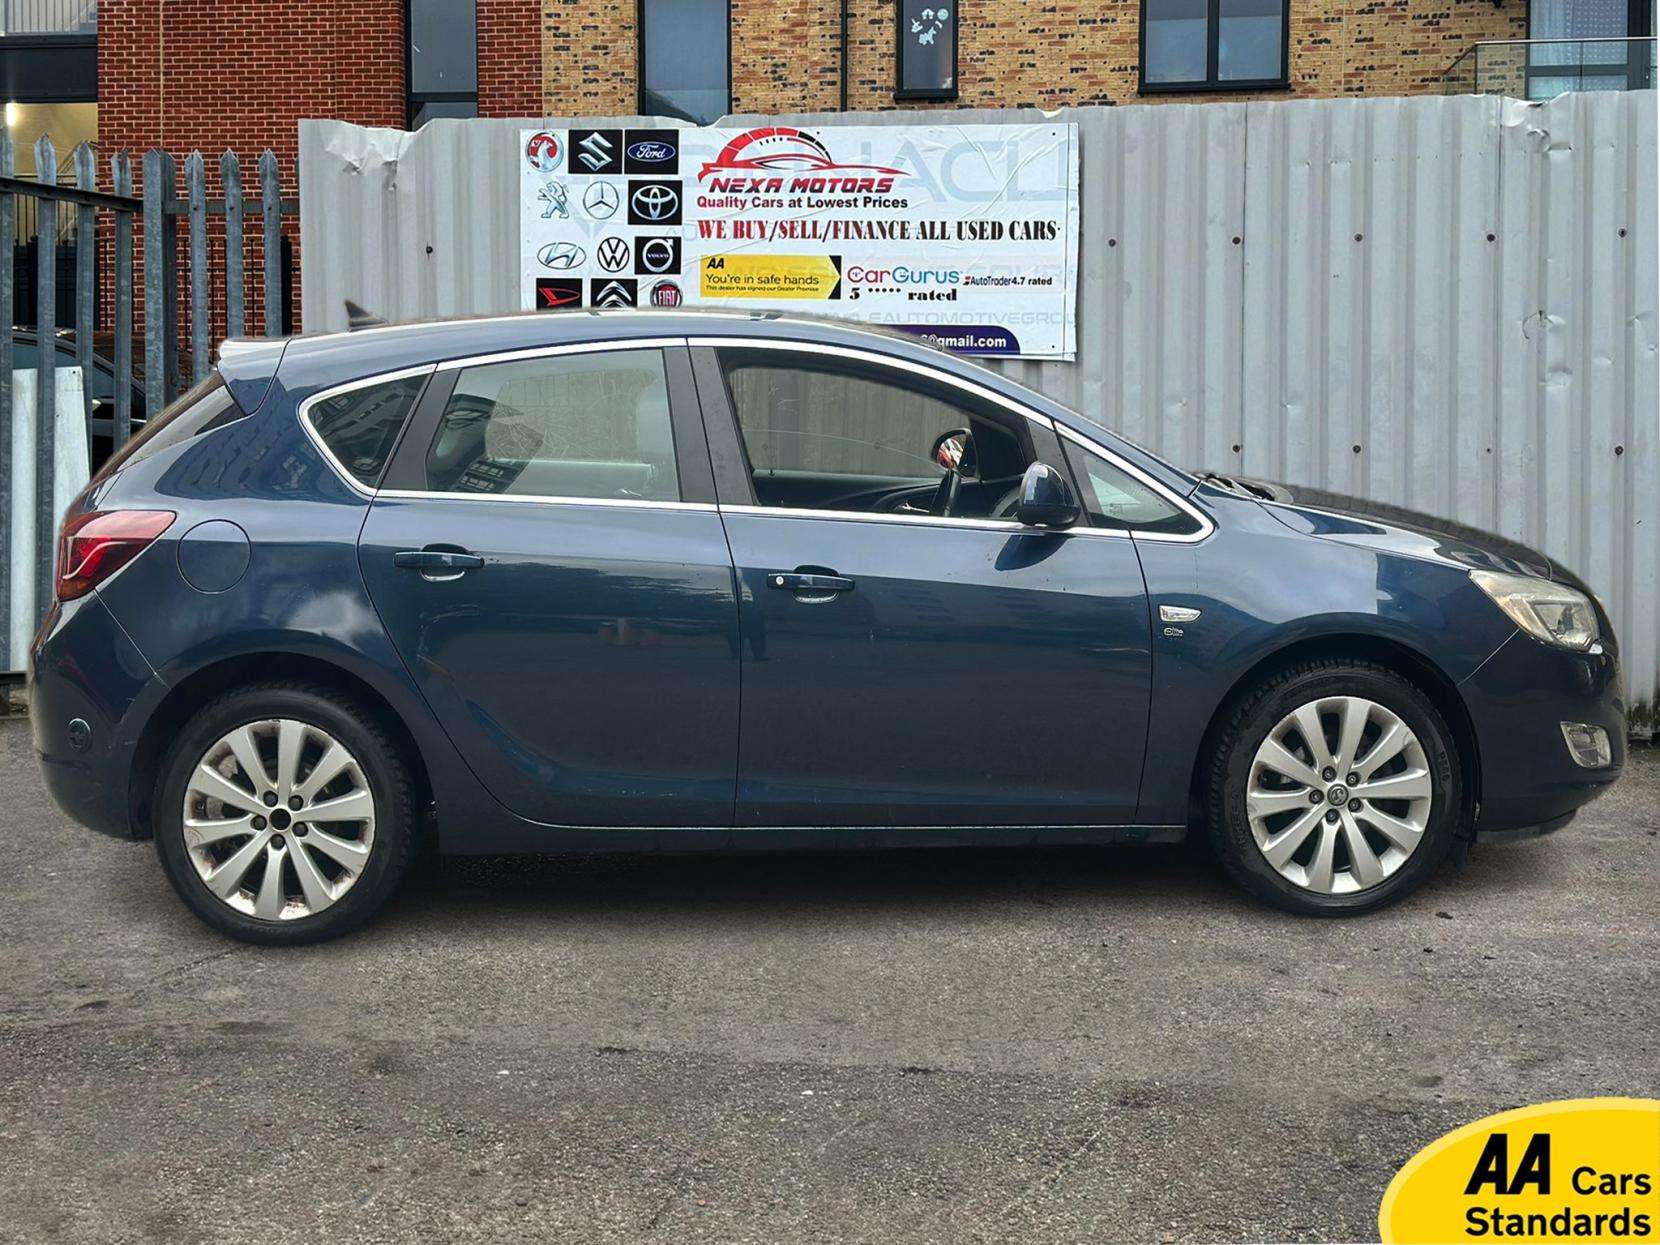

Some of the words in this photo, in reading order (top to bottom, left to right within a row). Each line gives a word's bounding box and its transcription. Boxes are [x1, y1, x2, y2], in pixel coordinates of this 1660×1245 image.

[636, 145, 667, 159] Ford
[709, 177, 784, 194] NEXA
[789, 177, 895, 194] MOTORS
[697, 196, 747, 211] Quality
[752, 196, 784, 209] Cars
[788, 197, 802, 208] at
[807, 196, 858, 209] Lowest
[863, 196, 908, 209] Prices
[697, 219, 726, 240] WE
[916, 220, 951, 241] ALL
[956, 220, 1004, 241] USED
[1008, 220, 1057, 241] CARS
[707, 257, 725, 270] AA
[706, 273, 741, 285] You're
[744, 273, 755, 284] in
[757, 273, 781, 285] safe
[784, 274, 820, 286] hands
[847, 265, 960, 284] CarGurus
[1028, 277, 1053, 286] rated
[658, 290, 676, 305] FIAT
[849, 287, 861, 300] 5
[908, 288, 957, 301] rated
